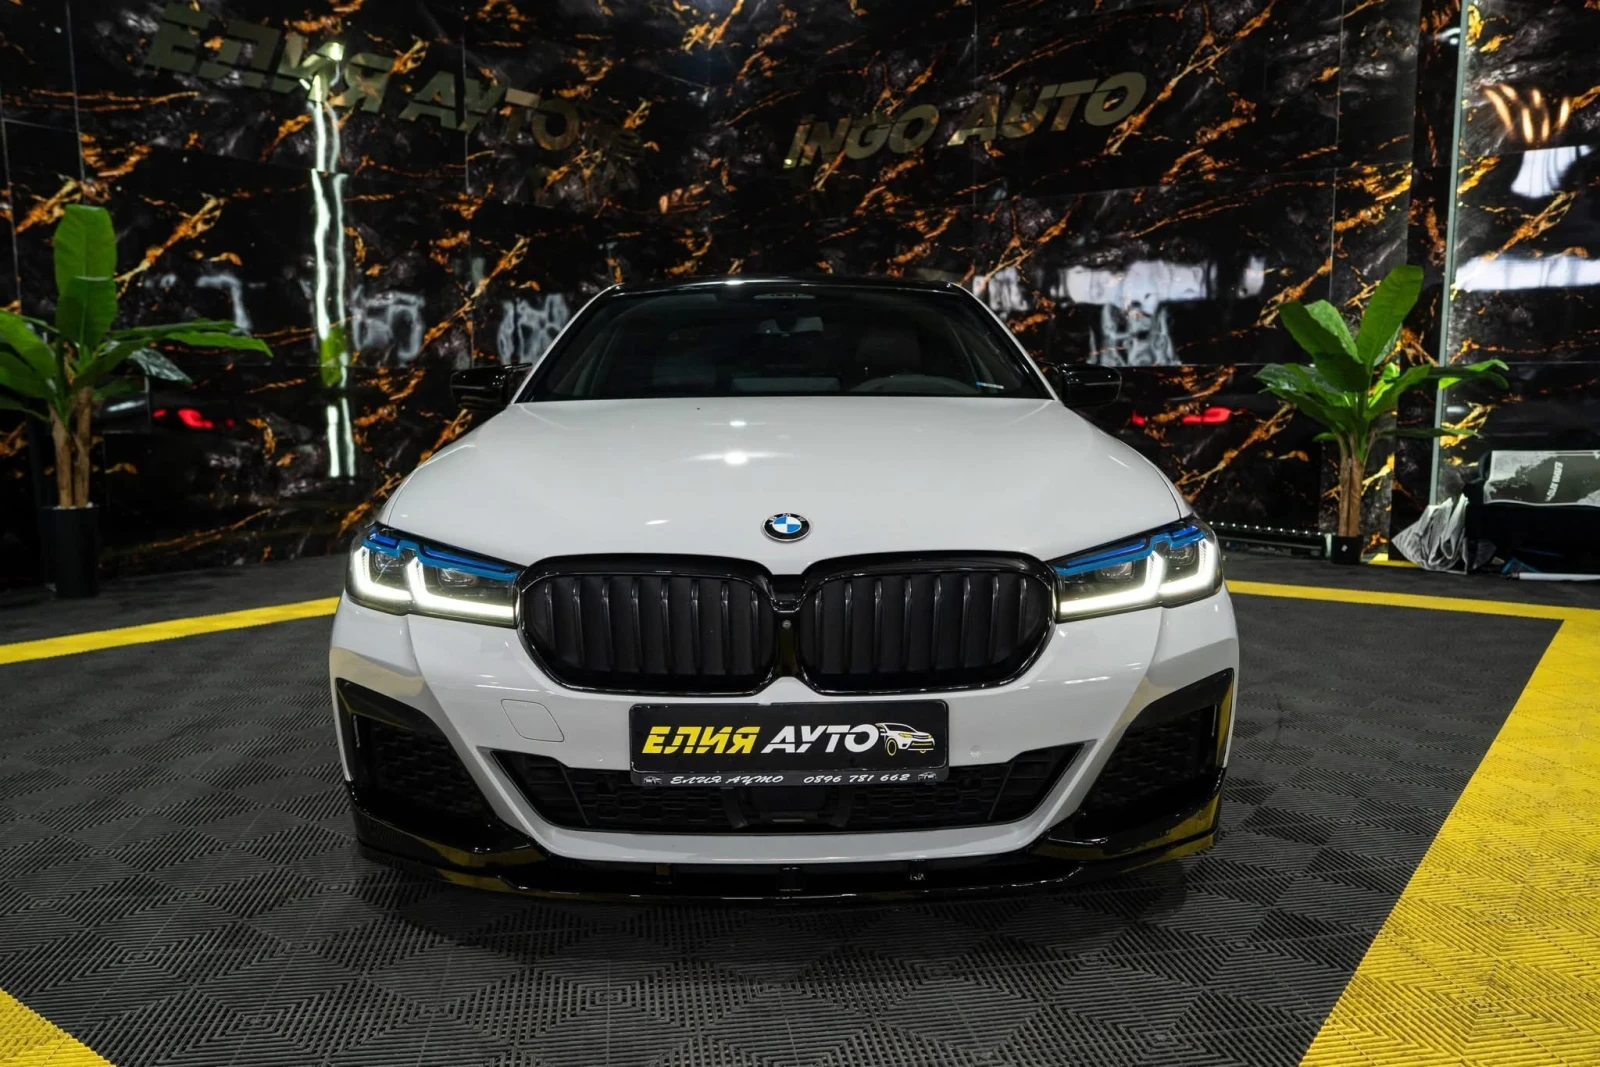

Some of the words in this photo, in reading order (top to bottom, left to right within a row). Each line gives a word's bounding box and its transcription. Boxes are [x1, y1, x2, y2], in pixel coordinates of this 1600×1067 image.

[145, 2, 394, 113] ЕЛИЯ
[399, 70, 580, 151] АУТО
[783, 103, 939, 169] INGO
[947, 71, 1147, 147] AUTO
[641, 726, 761, 754] ЕЛИЯ
[760, 724, 879, 754] АУТО
[803, 774, 842, 784] 0896
[849, 774, 874, 783] 781
